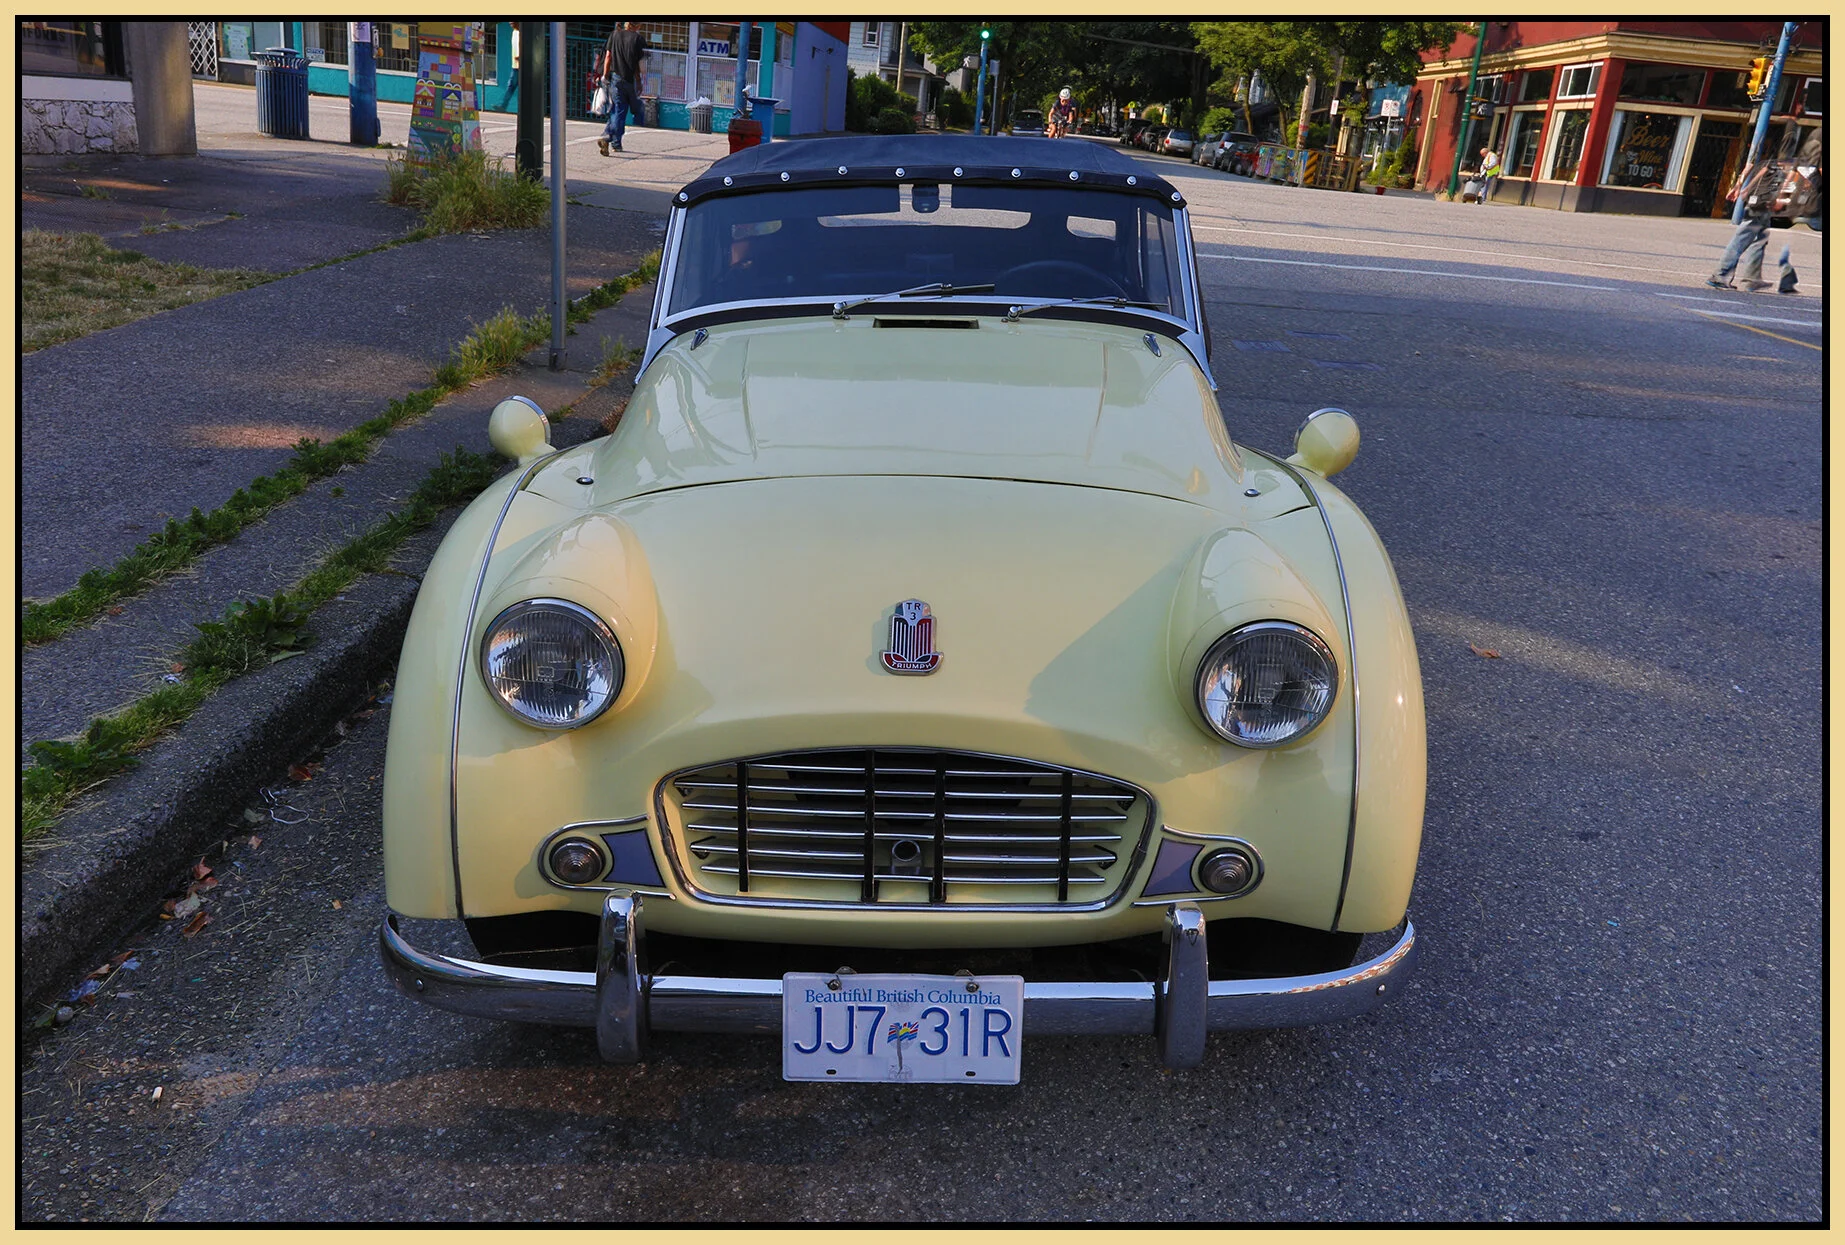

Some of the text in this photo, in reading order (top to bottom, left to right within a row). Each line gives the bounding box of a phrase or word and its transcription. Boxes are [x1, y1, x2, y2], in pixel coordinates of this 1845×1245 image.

[698, 41, 729, 54] ATM
[1626, 126, 1670, 147] Beer
[1628, 164, 1653, 178] TO GO
[906, 602, 921, 611] TR
[910, 612, 917, 620] 3
[891, 661, 932, 670] TRIUMPH
[805, 988, 1001, 1005] Beautiful British Columbia
[793, 1005, 1013, 1057] JJ7 31R
